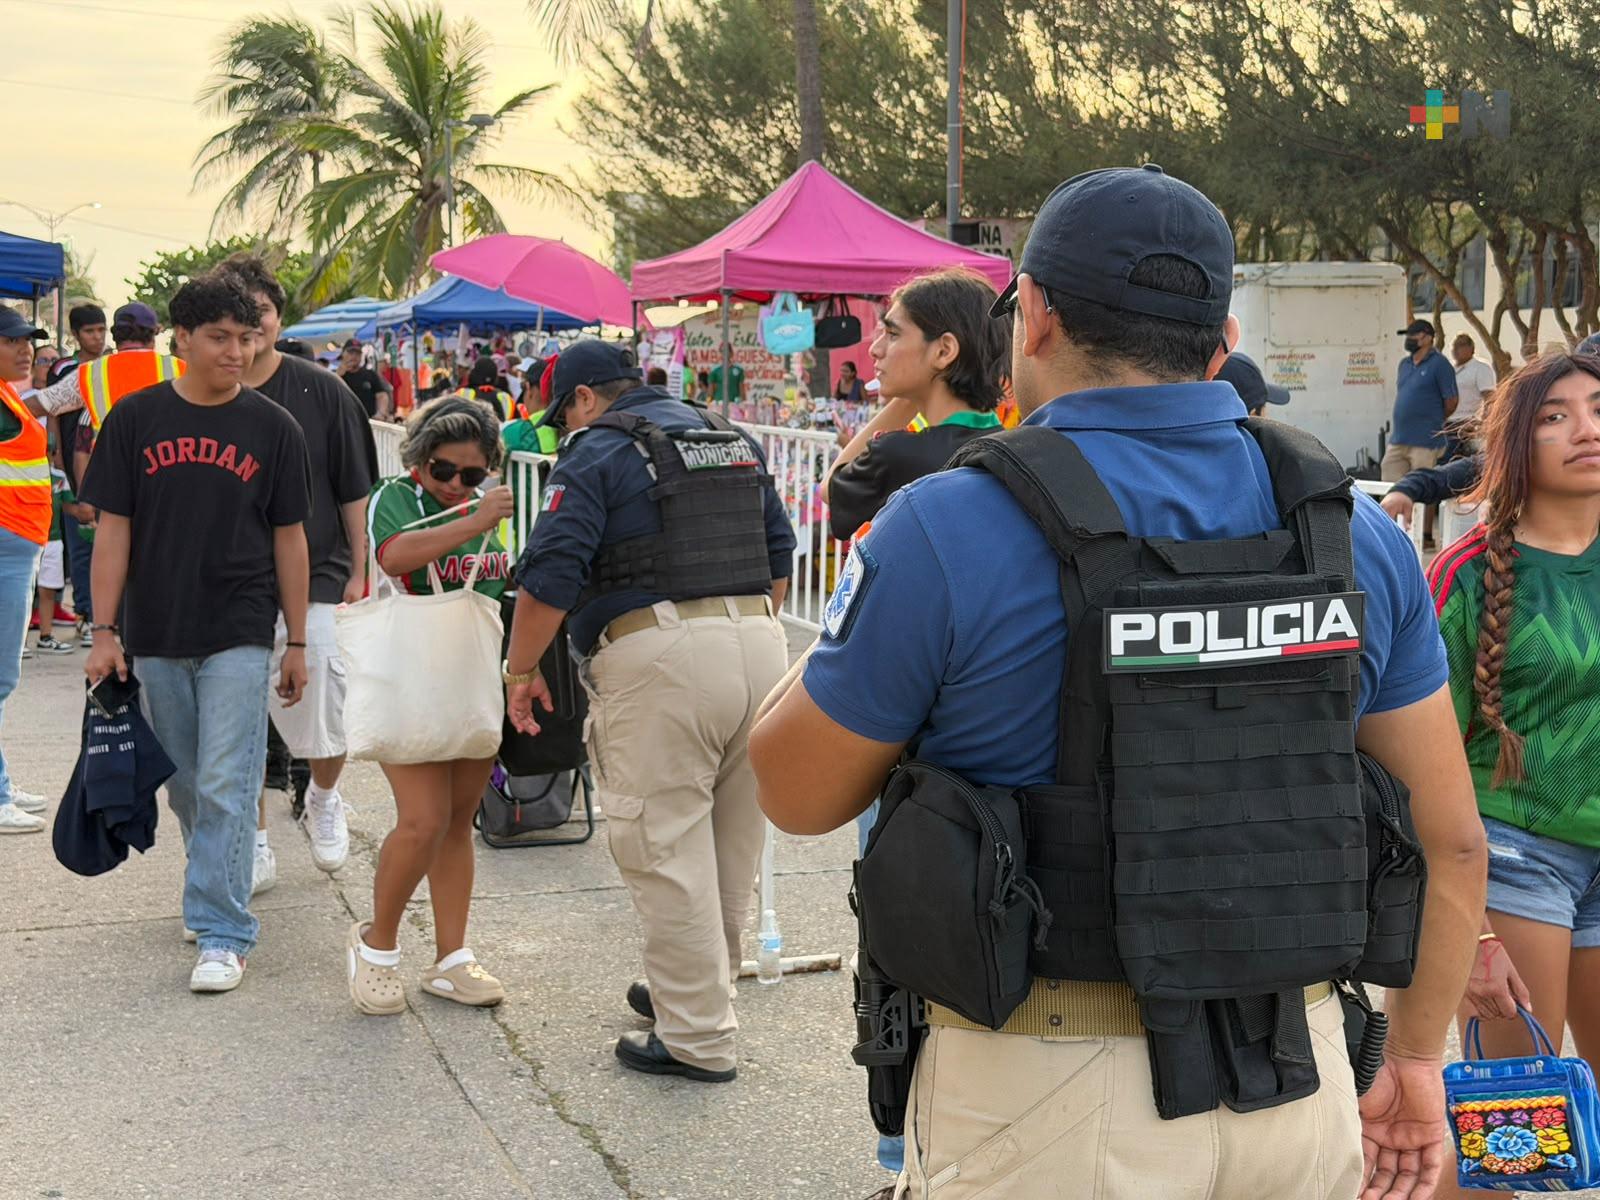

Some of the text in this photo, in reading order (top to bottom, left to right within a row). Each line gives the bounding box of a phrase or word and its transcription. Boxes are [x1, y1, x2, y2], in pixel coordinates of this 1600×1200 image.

[687, 349, 783, 364] AMBGUESAS
[143, 437, 260, 482] JORDAN
[681, 447, 757, 467] MUNICIPAL
[427, 552, 509, 586] MEXI
[1111, 598, 1359, 656] POLICIA
